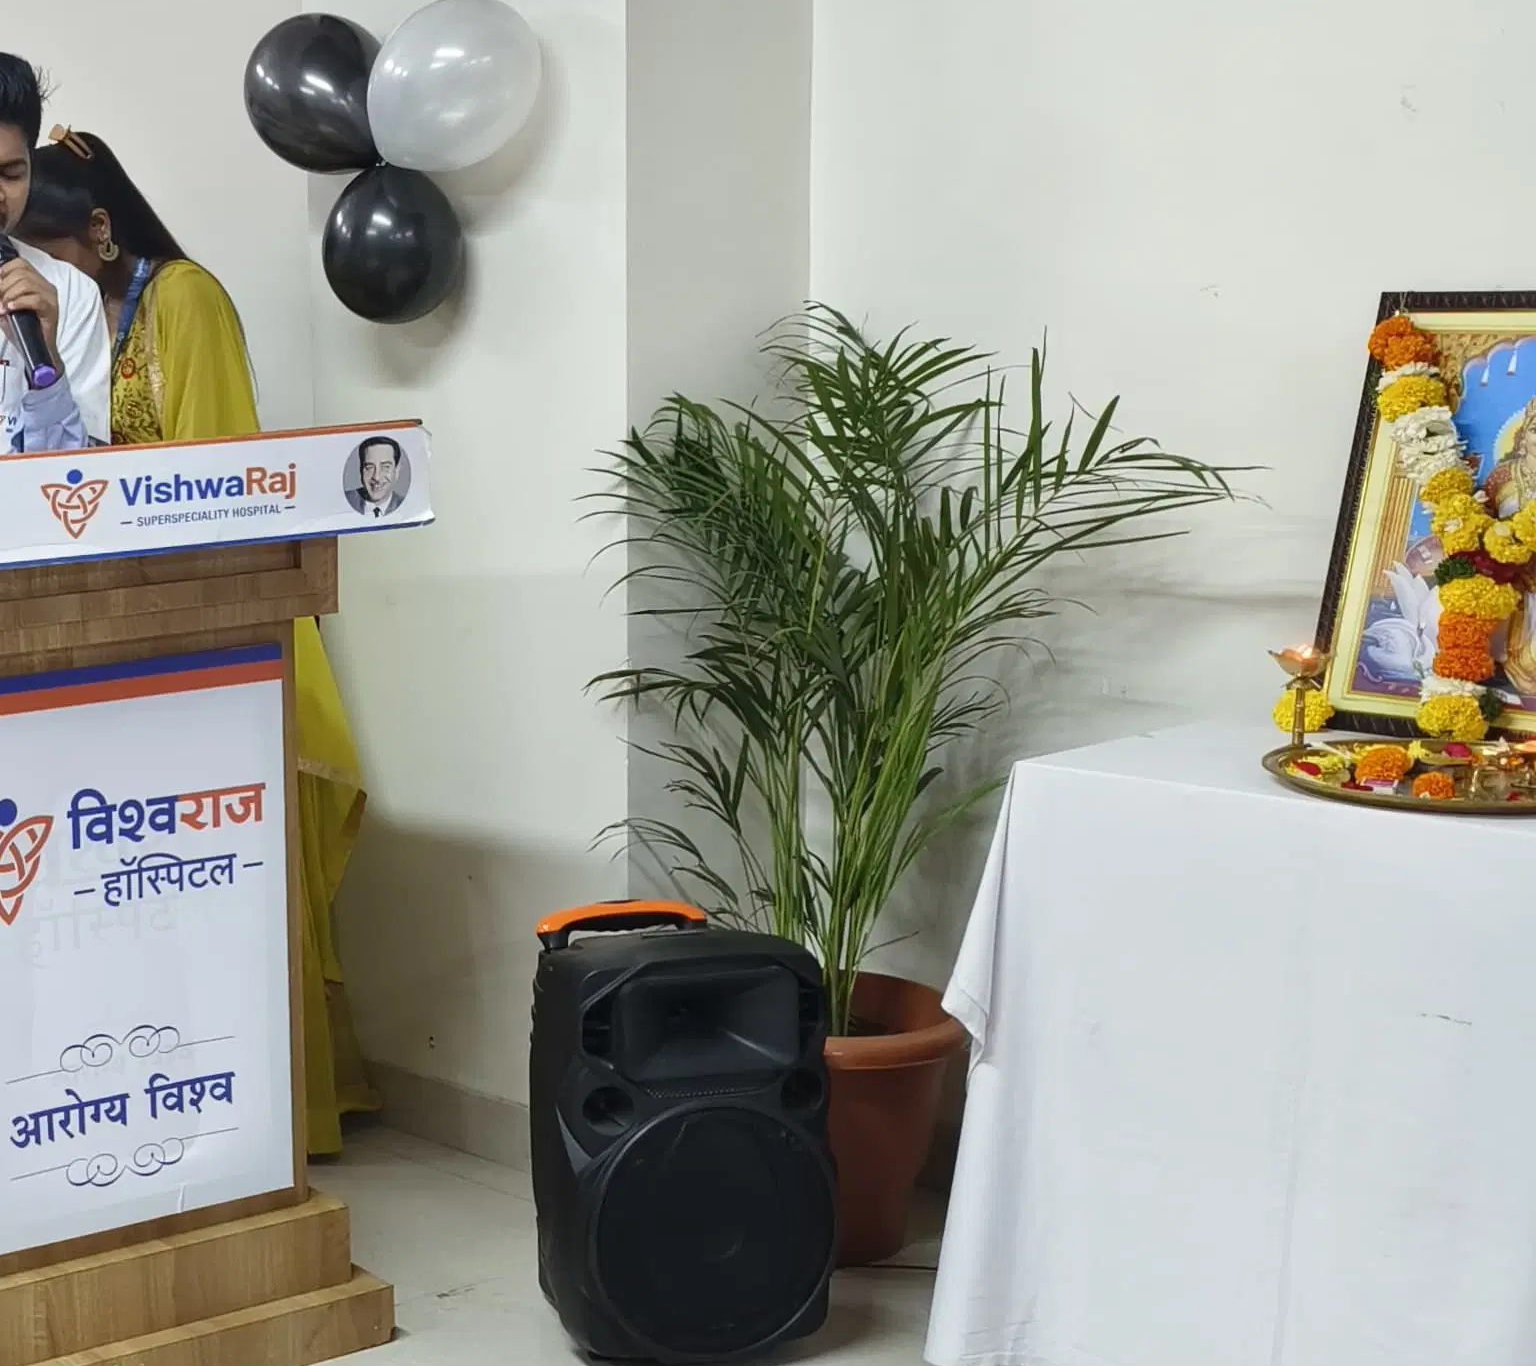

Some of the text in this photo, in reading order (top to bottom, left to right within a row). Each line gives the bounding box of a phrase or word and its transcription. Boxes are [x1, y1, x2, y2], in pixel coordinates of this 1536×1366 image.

[119, 462, 297, 507] VishwaRaj
[136, 504, 282, 527] SUPERSPECIALITY HOSPITAL
[67, 782, 266, 850] विश्वराज
[100, 852, 237, 907] हॉस्पिटल
[9, 1071, 236, 1149] आरोग्य विश्व
